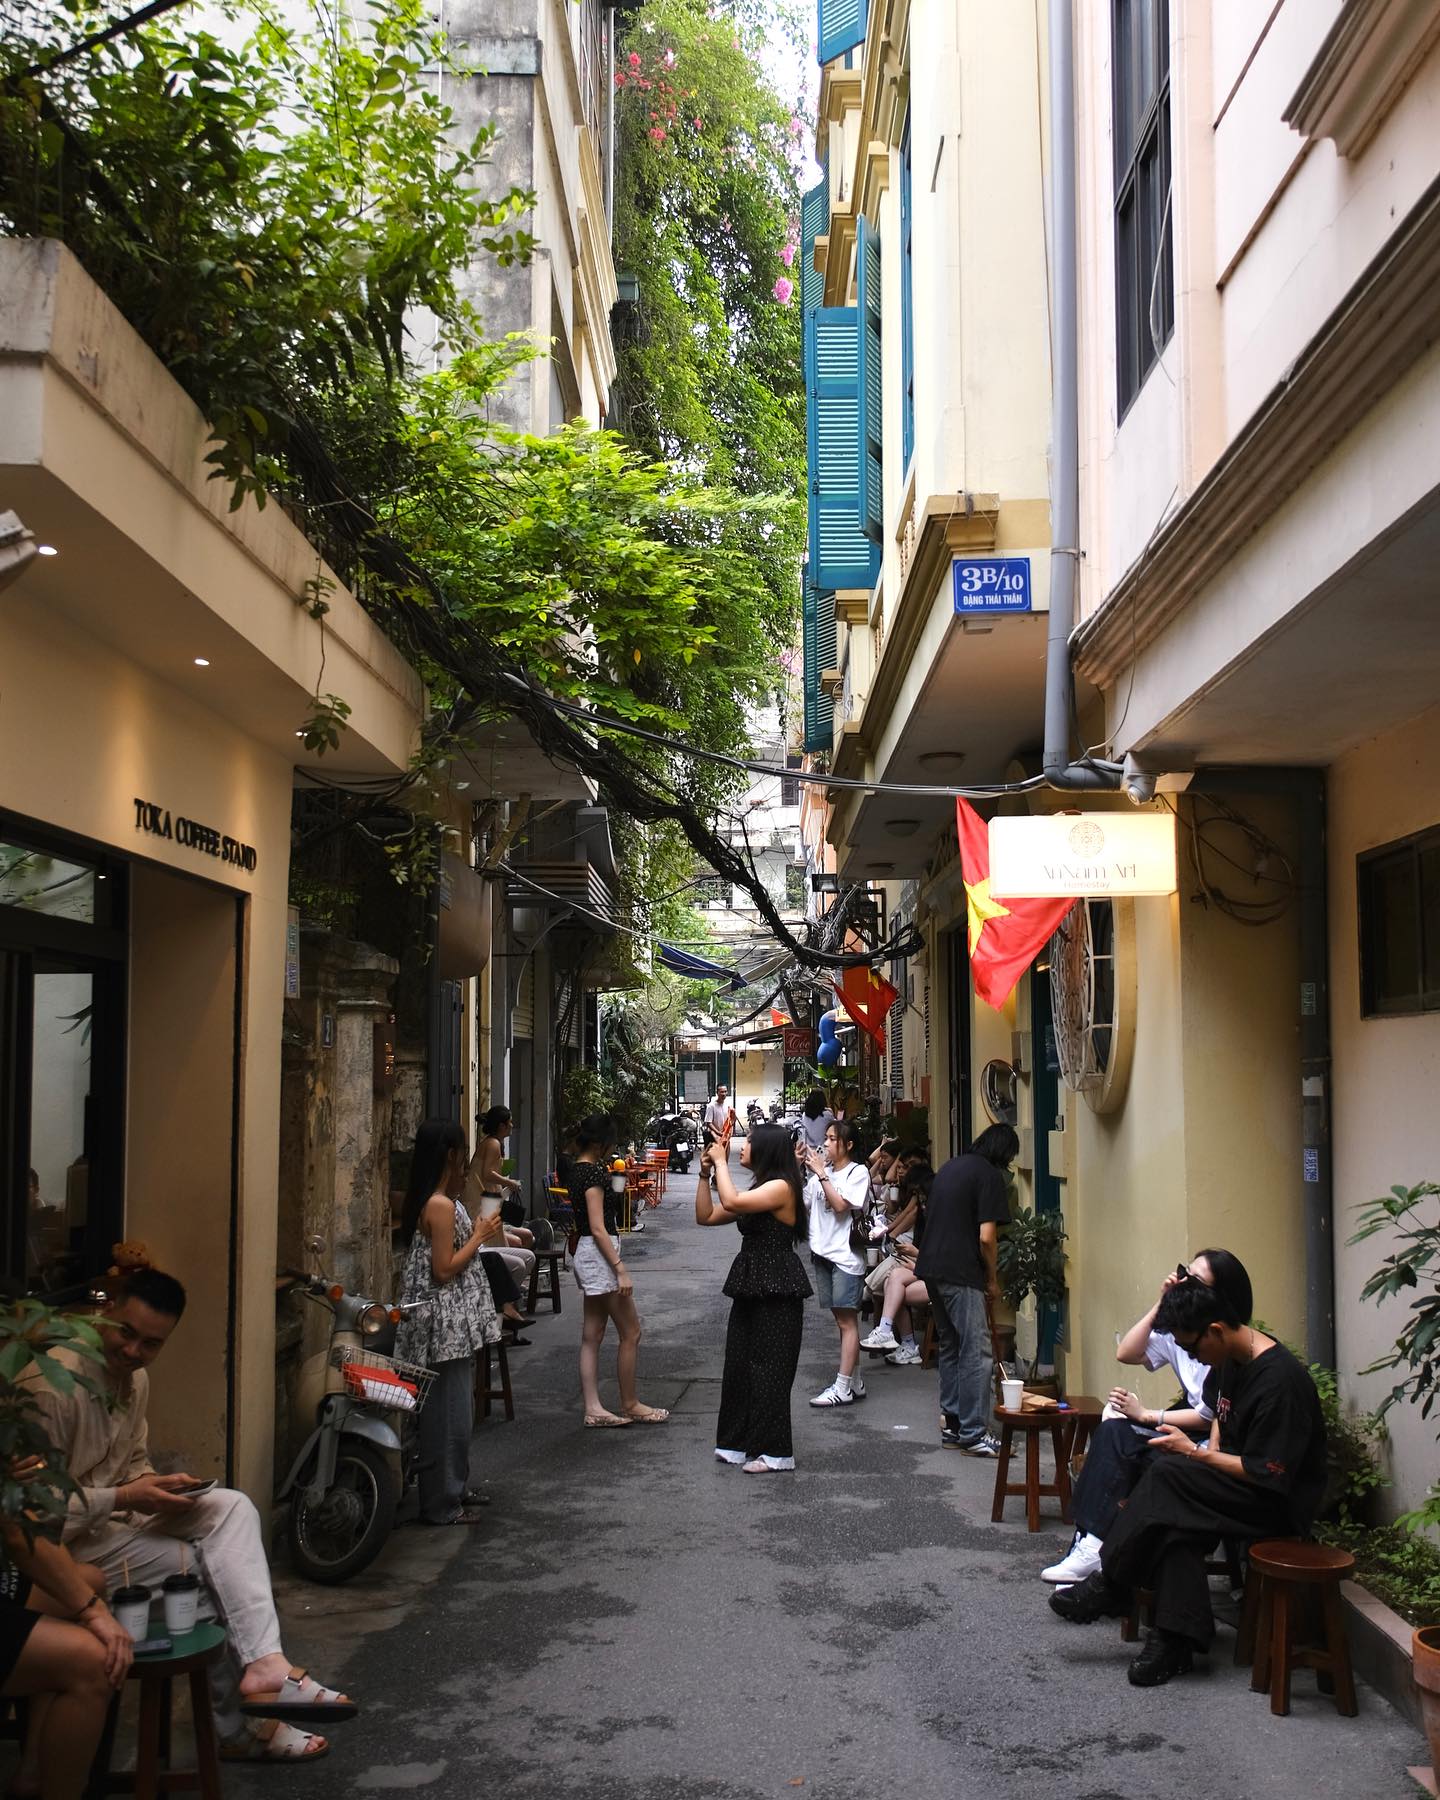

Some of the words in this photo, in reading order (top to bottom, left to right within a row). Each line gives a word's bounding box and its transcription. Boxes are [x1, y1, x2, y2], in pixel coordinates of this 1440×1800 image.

[961, 566, 1024, 592] 3B/10
[134, 798, 173, 840] TOKA
[175, 817, 221, 857] COFFEE
[221, 835, 257, 871] STAND
